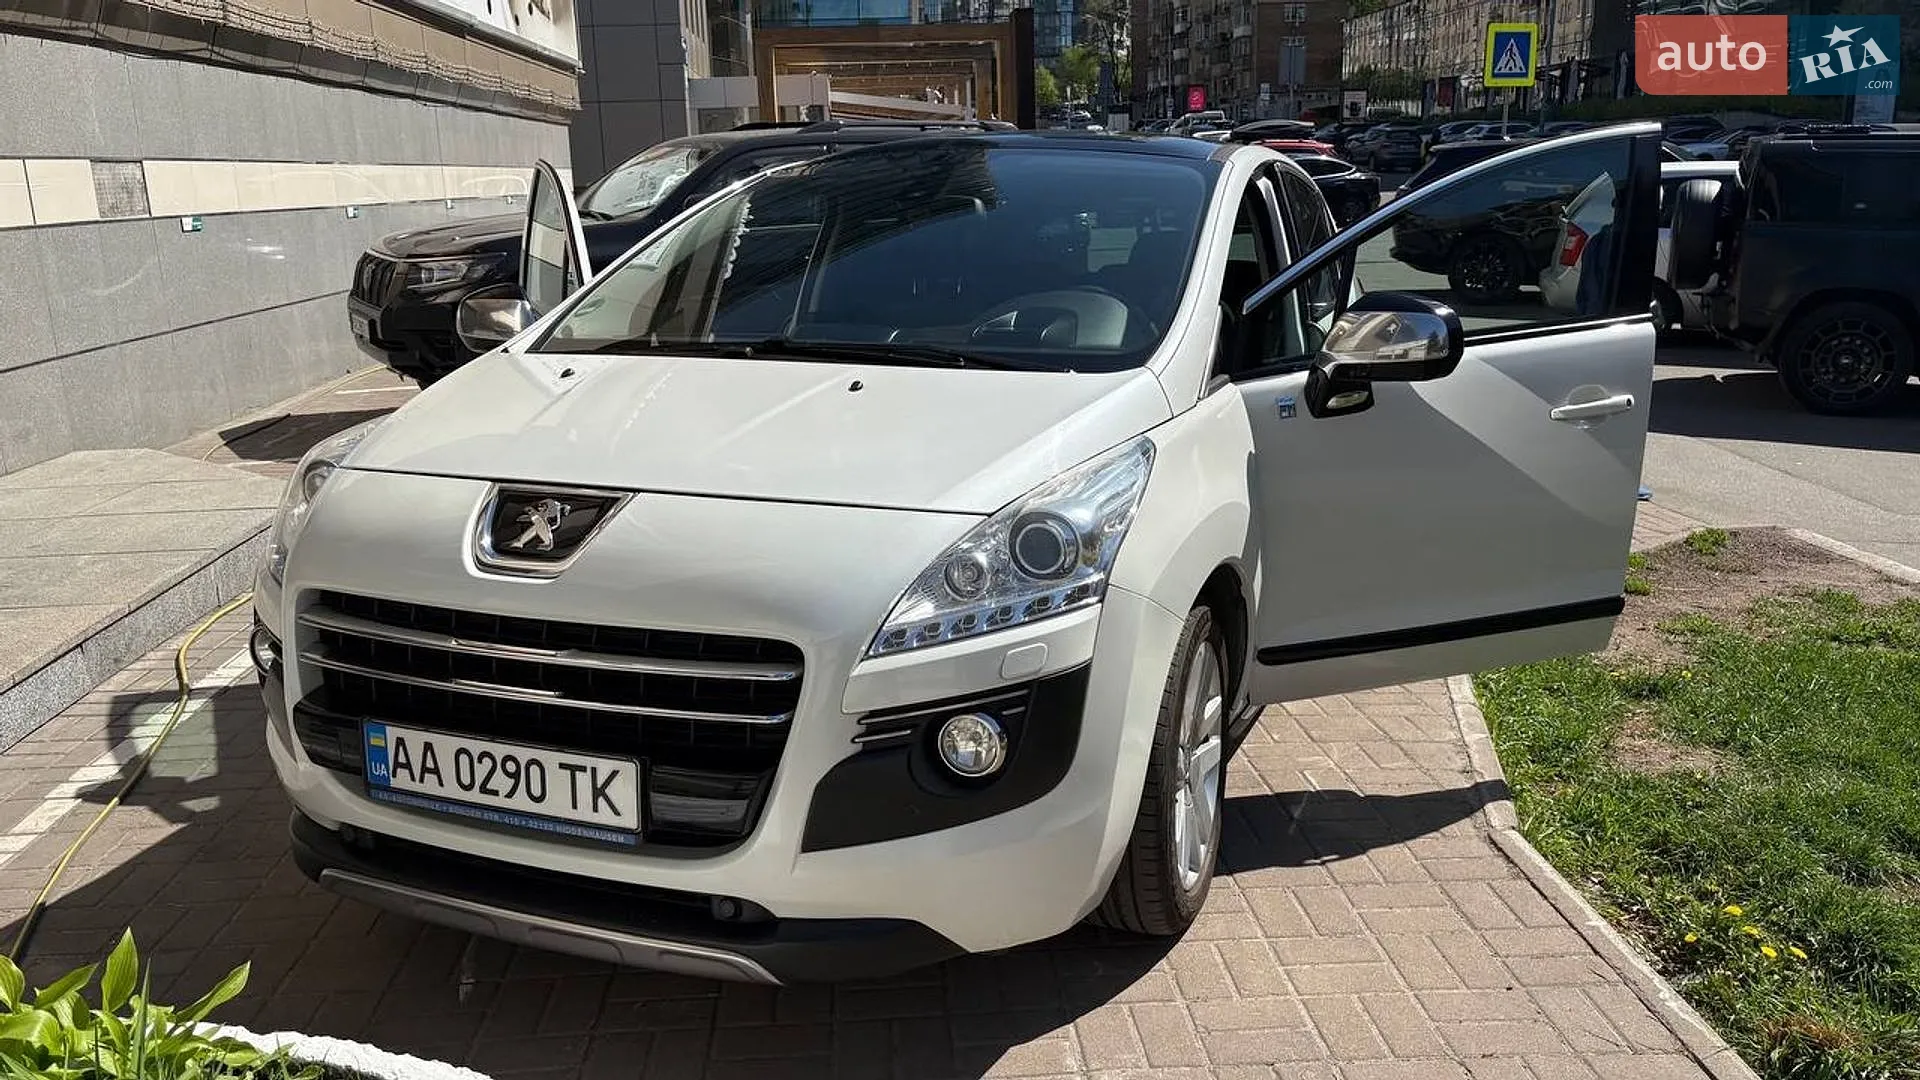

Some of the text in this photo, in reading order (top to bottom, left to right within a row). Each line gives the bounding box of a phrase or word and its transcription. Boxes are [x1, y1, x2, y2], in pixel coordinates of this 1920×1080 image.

[371, 761, 389, 777] UA
[391, 736, 444, 787] AA
[454, 747, 548, 804] 0290
[558, 762, 622, 817] TK
